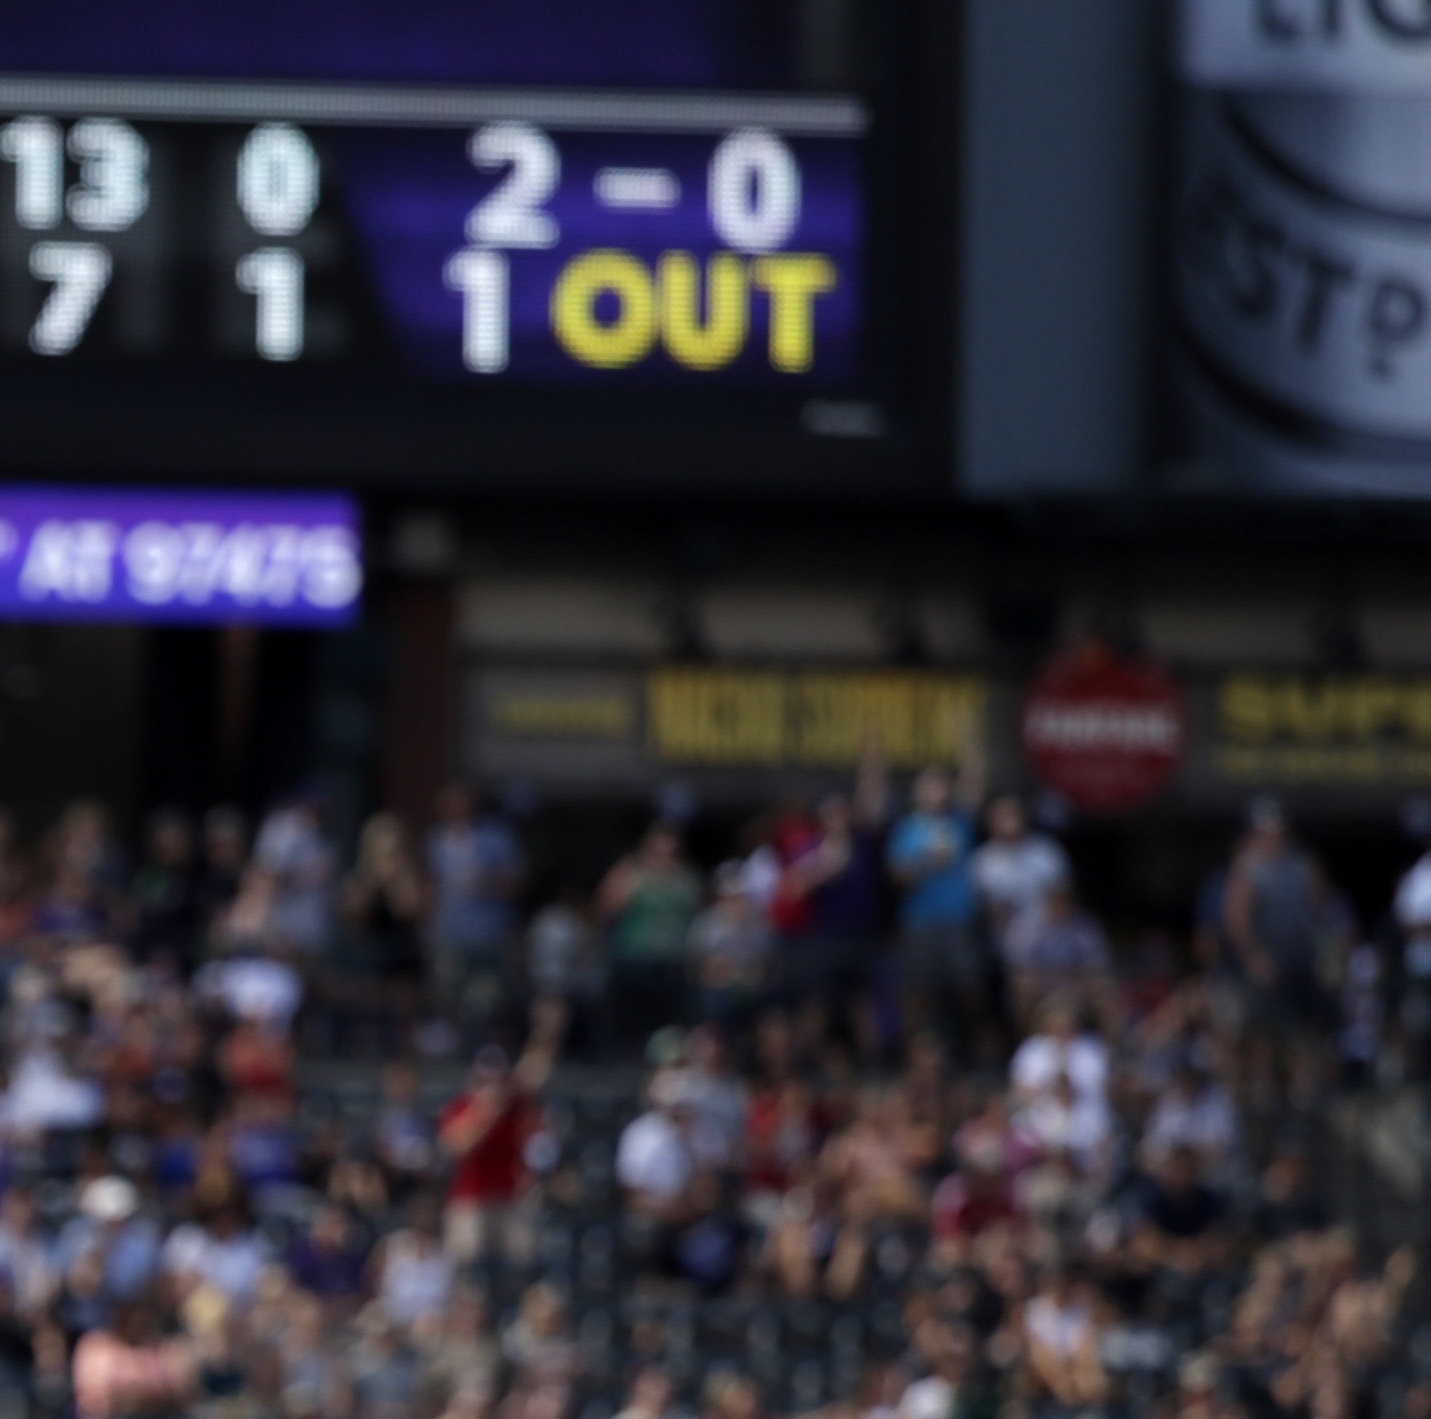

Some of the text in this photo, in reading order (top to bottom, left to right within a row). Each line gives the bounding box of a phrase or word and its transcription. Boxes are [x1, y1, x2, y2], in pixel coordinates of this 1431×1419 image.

[236, 123, 318, 236] 0
[29, 242, 111, 354] 7
[237, 248, 305, 360] 1
[444, 247, 837, 373] 1 OUT
[19, 519, 120, 603] AT
